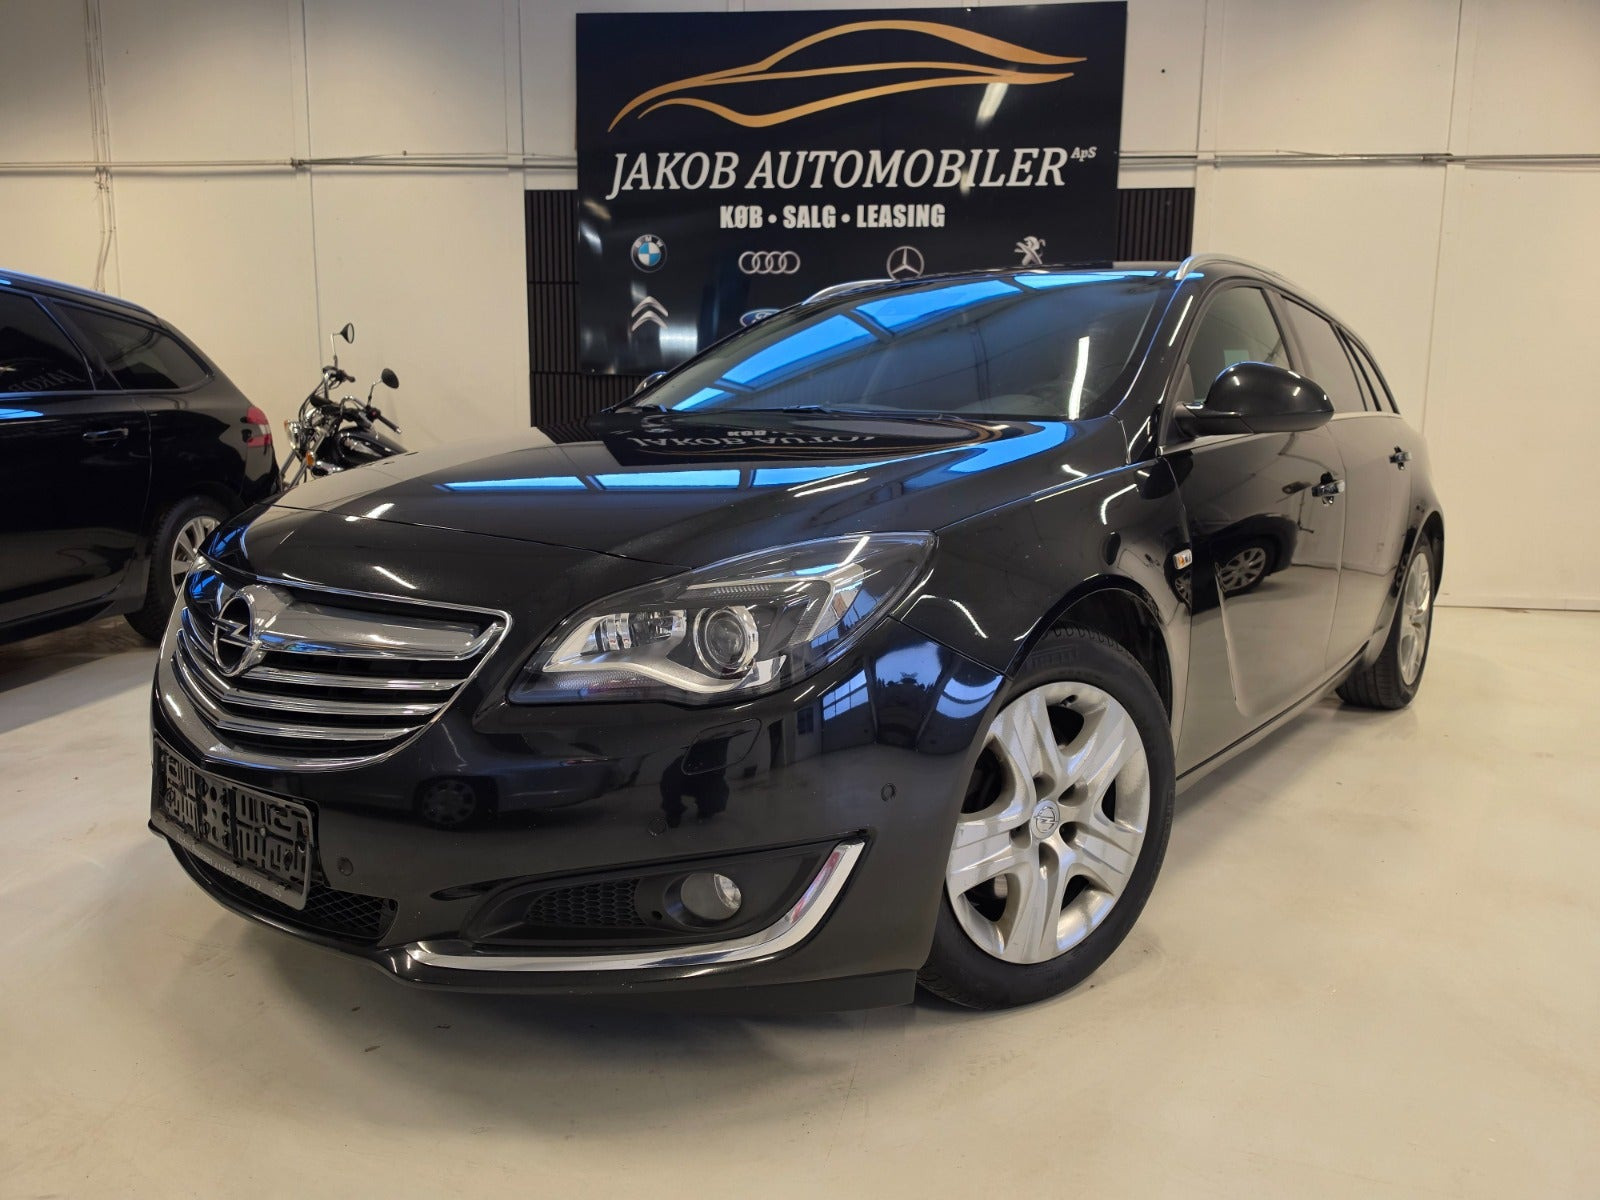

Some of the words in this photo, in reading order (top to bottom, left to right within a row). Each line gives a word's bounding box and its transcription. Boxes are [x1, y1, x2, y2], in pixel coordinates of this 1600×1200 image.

[605, 151, 740, 200] JAKOB
[744, 147, 1069, 189] AUTOMOBILER
[1070, 146, 1097, 162] ApS
[719, 205, 763, 228] KØB
[782, 205, 836, 228] SALG
[856, 203, 946, 228] LEASING
